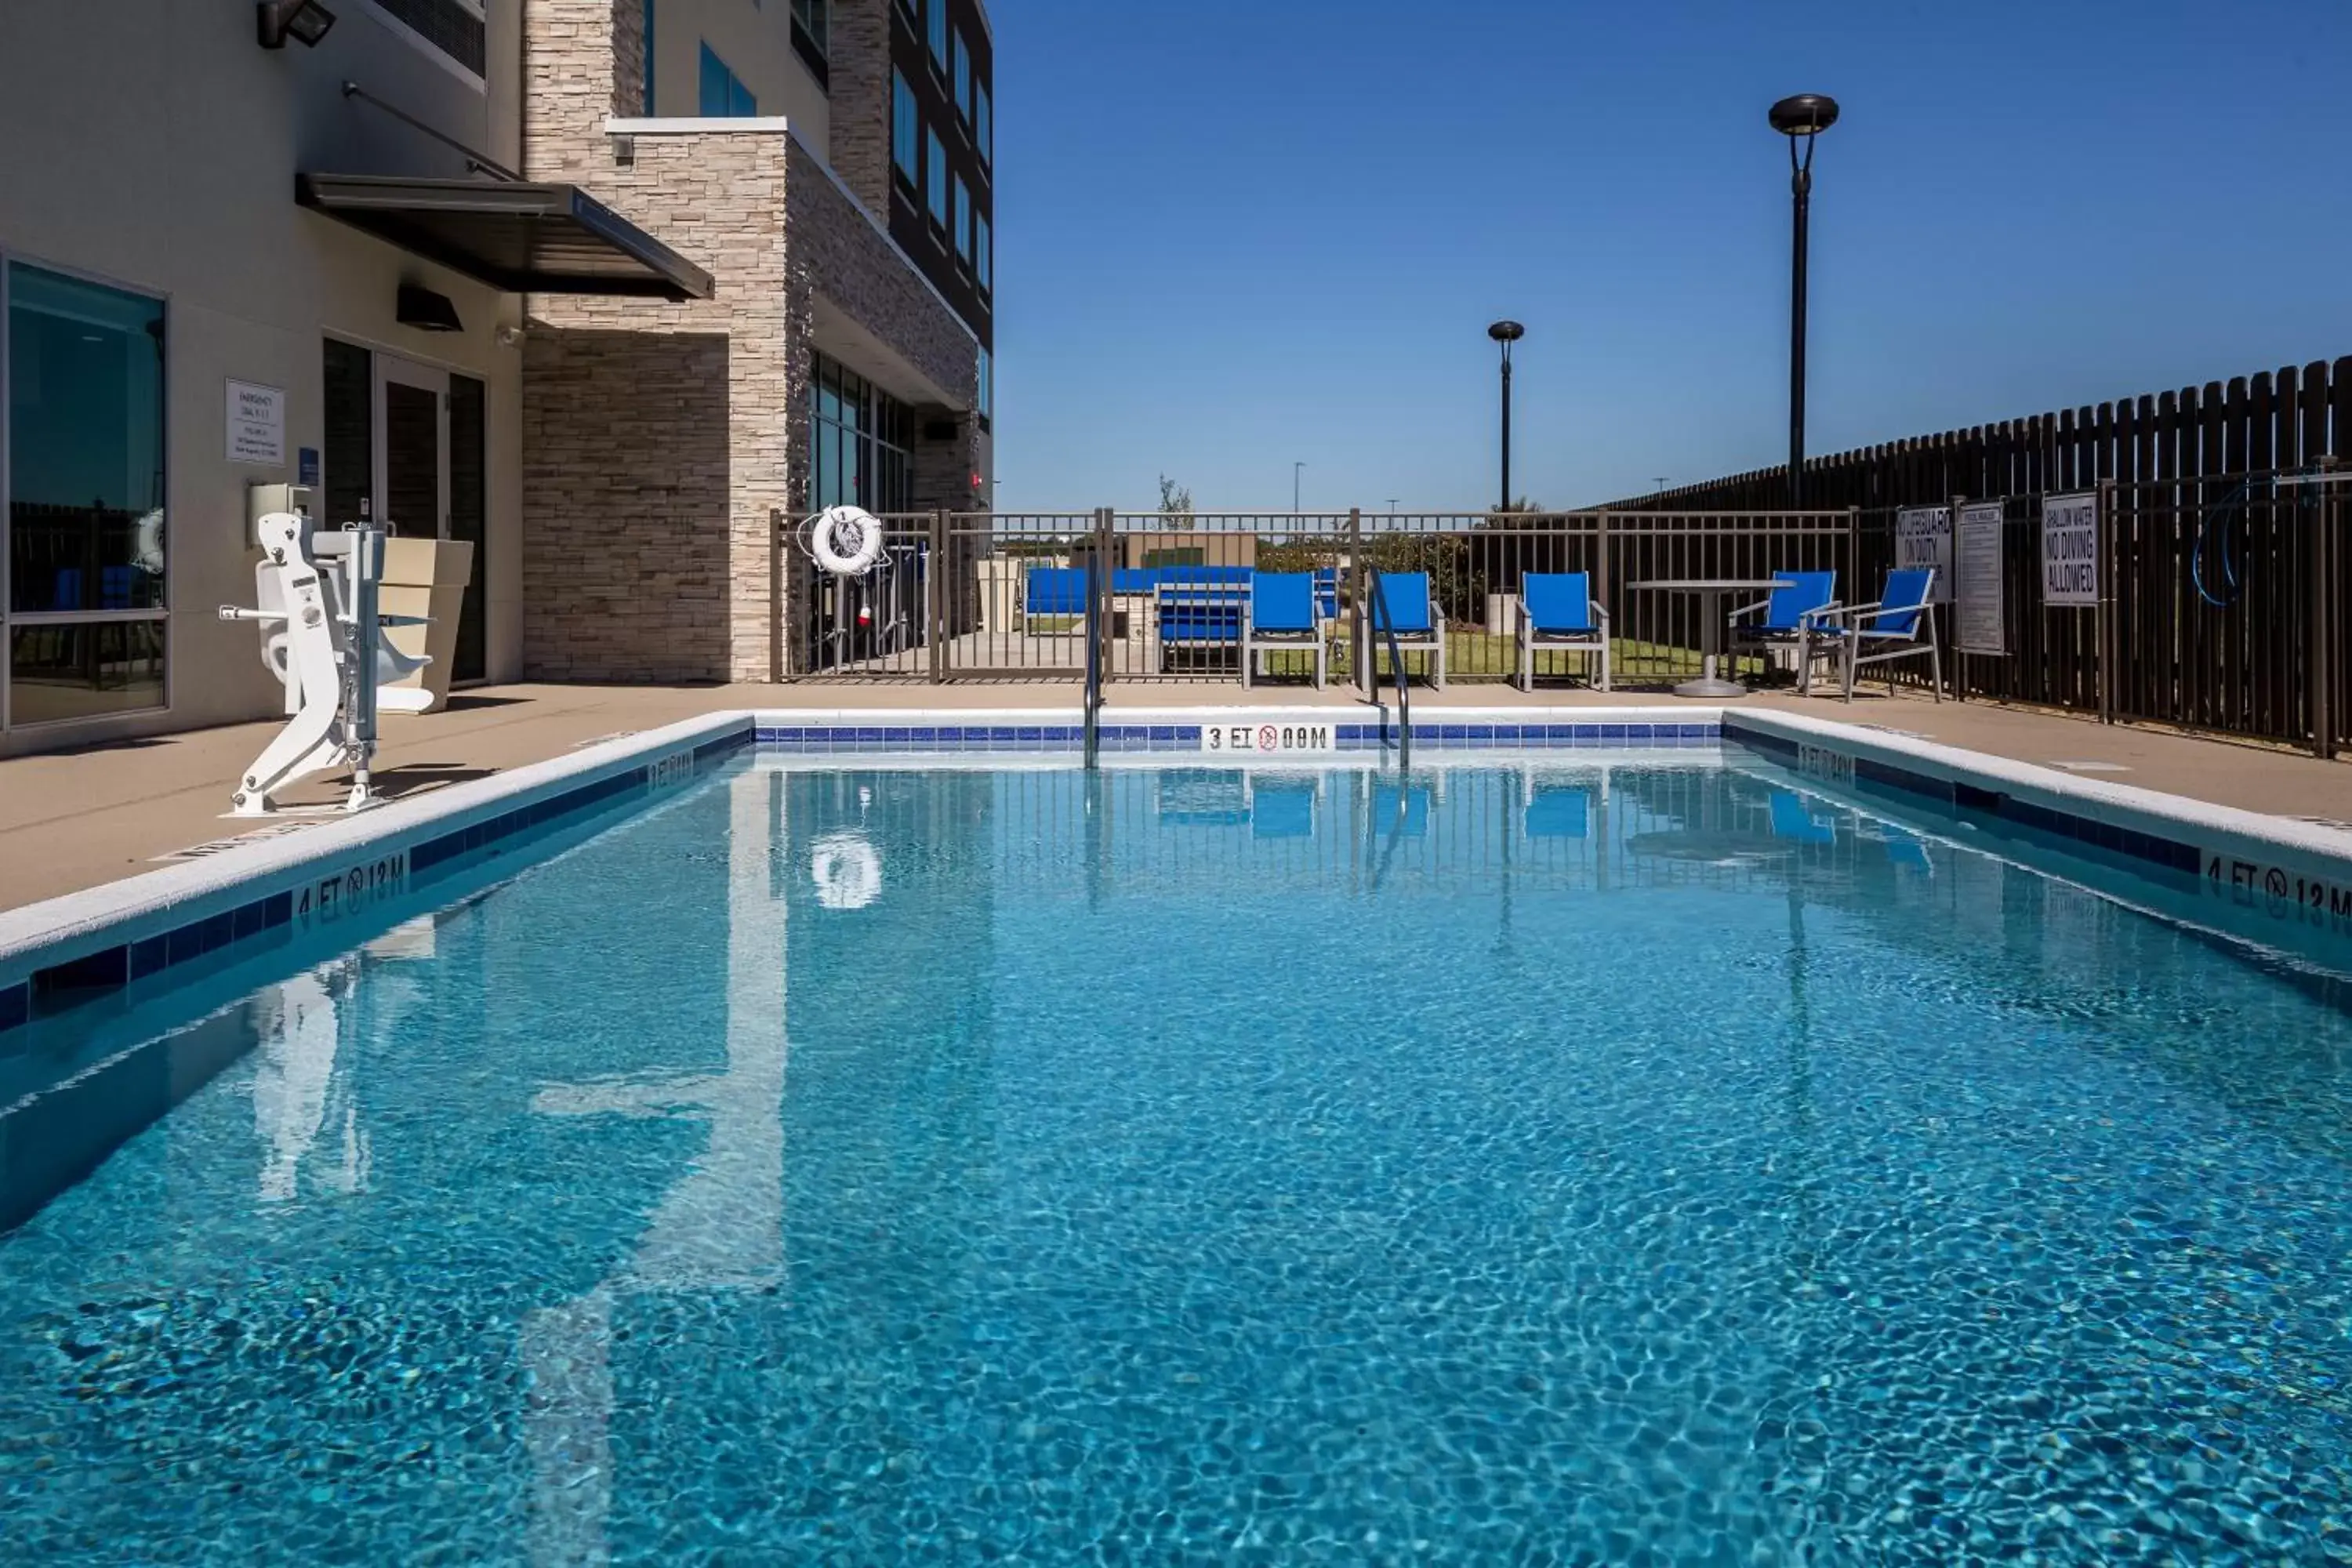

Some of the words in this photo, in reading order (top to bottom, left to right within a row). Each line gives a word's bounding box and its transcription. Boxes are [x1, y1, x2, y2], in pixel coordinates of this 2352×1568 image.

[1896, 513, 1905, 536] NO
[1906, 510, 1951, 535] LIFEGUARD
[2046, 508, 2071, 528] SHALLOW
[2073, 506, 2092, 526] WATER
[1905, 539, 1915, 563] ON
[1916, 537, 1938, 563] DUTY
[2046, 532, 2058, 561] NO
[2061, 529, 2093, 561] DIVING
[2049, 564, 2094, 593] ALLOWED
[1209, 727, 1221, 748] 3
